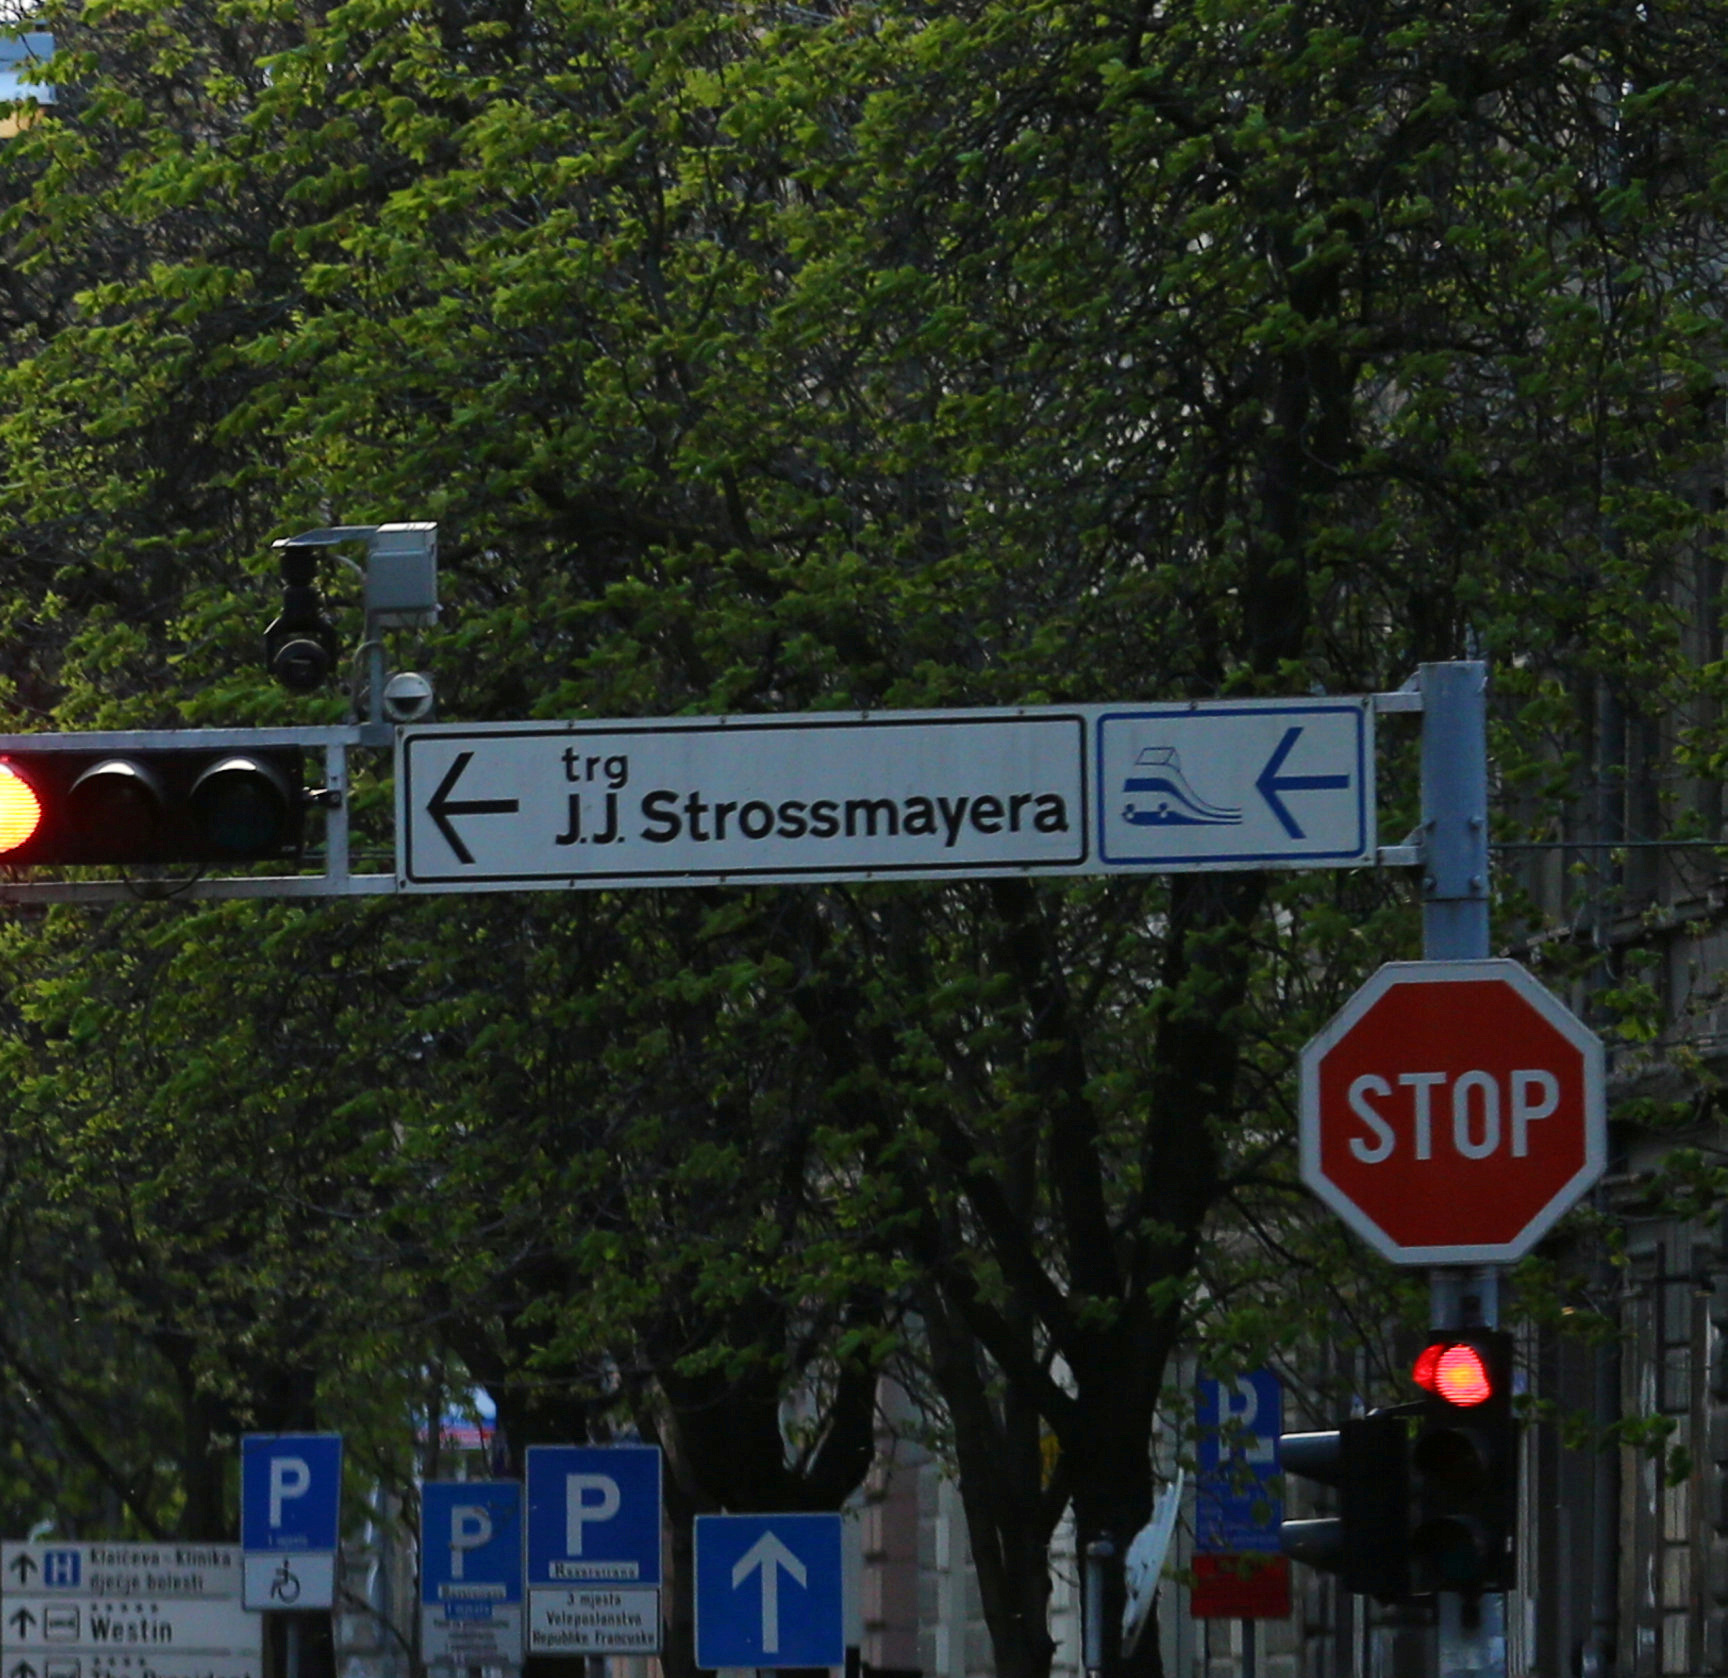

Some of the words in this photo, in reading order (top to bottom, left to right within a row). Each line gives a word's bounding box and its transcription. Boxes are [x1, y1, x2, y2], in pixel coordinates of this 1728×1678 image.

[562, 747, 628, 789] trg
[554, 792, 625, 845] J.J.
[641, 789, 1069, 849] Strossmayera
[1348, 1069, 1560, 1164] STOP
[270, 1457, 311, 1528] P
[566, 1473, 621, 1556] P
[176, 1549, 232, 1567] Klinika
[451, 1504, 493, 1579] P
[146, 1573, 204, 1591] bolesti
[90, 1615, 173, 1643] Westin
